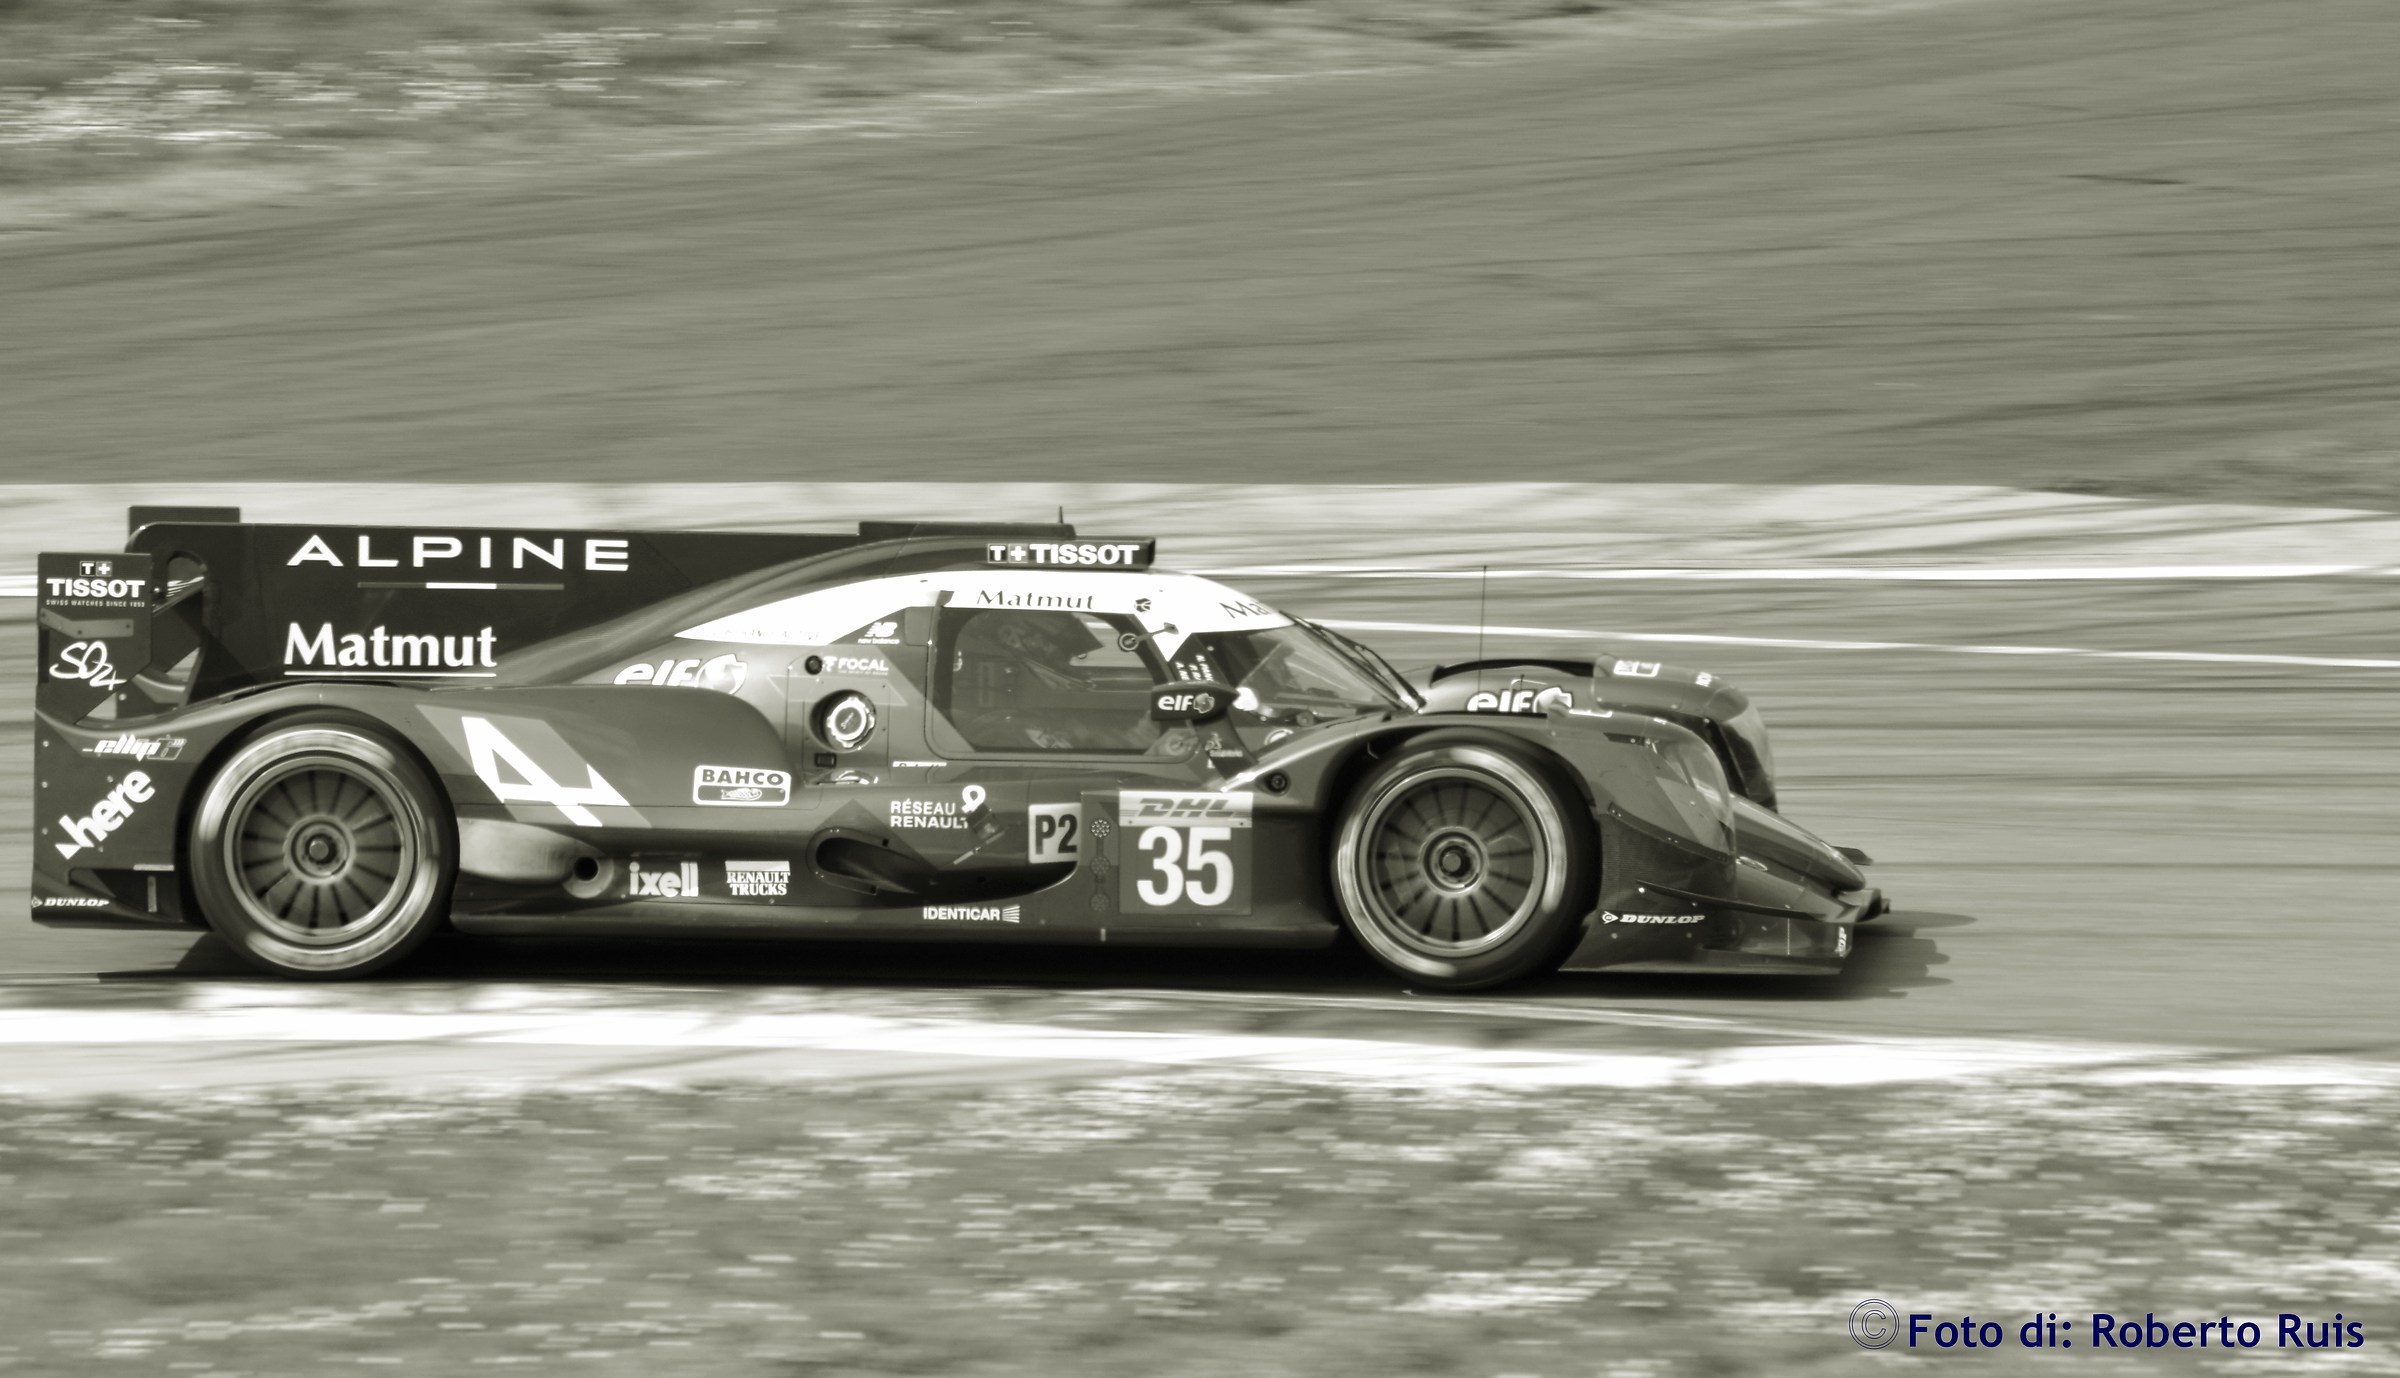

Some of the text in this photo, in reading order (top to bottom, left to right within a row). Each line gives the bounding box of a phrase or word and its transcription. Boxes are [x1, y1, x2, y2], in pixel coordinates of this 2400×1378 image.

[286, 534, 629, 571] ALPINE
[1029, 543, 1140, 565] TISSOT
[46, 578, 145, 598] TISSOT
[976, 589, 1093, 610] Matmut
[284, 622, 497, 668] Matmut
[838, 657, 889, 671] FOCAL
[702, 768, 783, 786] BAHCO
[58, 771, 155, 847] here
[890, 797, 956, 816] RÉSEAU
[1138, 798, 1234, 818] DHL
[1035, 813, 1078, 855] P2
[1137, 825, 1234, 906] 35
[629, 861, 699, 898] ixell
[726, 871, 791, 884] RENAULT
[729, 883, 787, 896] TRUCKS
[44, 897, 110, 907] DUNLOP
[923, 906, 1001, 921] IDENTICAR
[1620, 914, 1705, 924] DUNLOP
